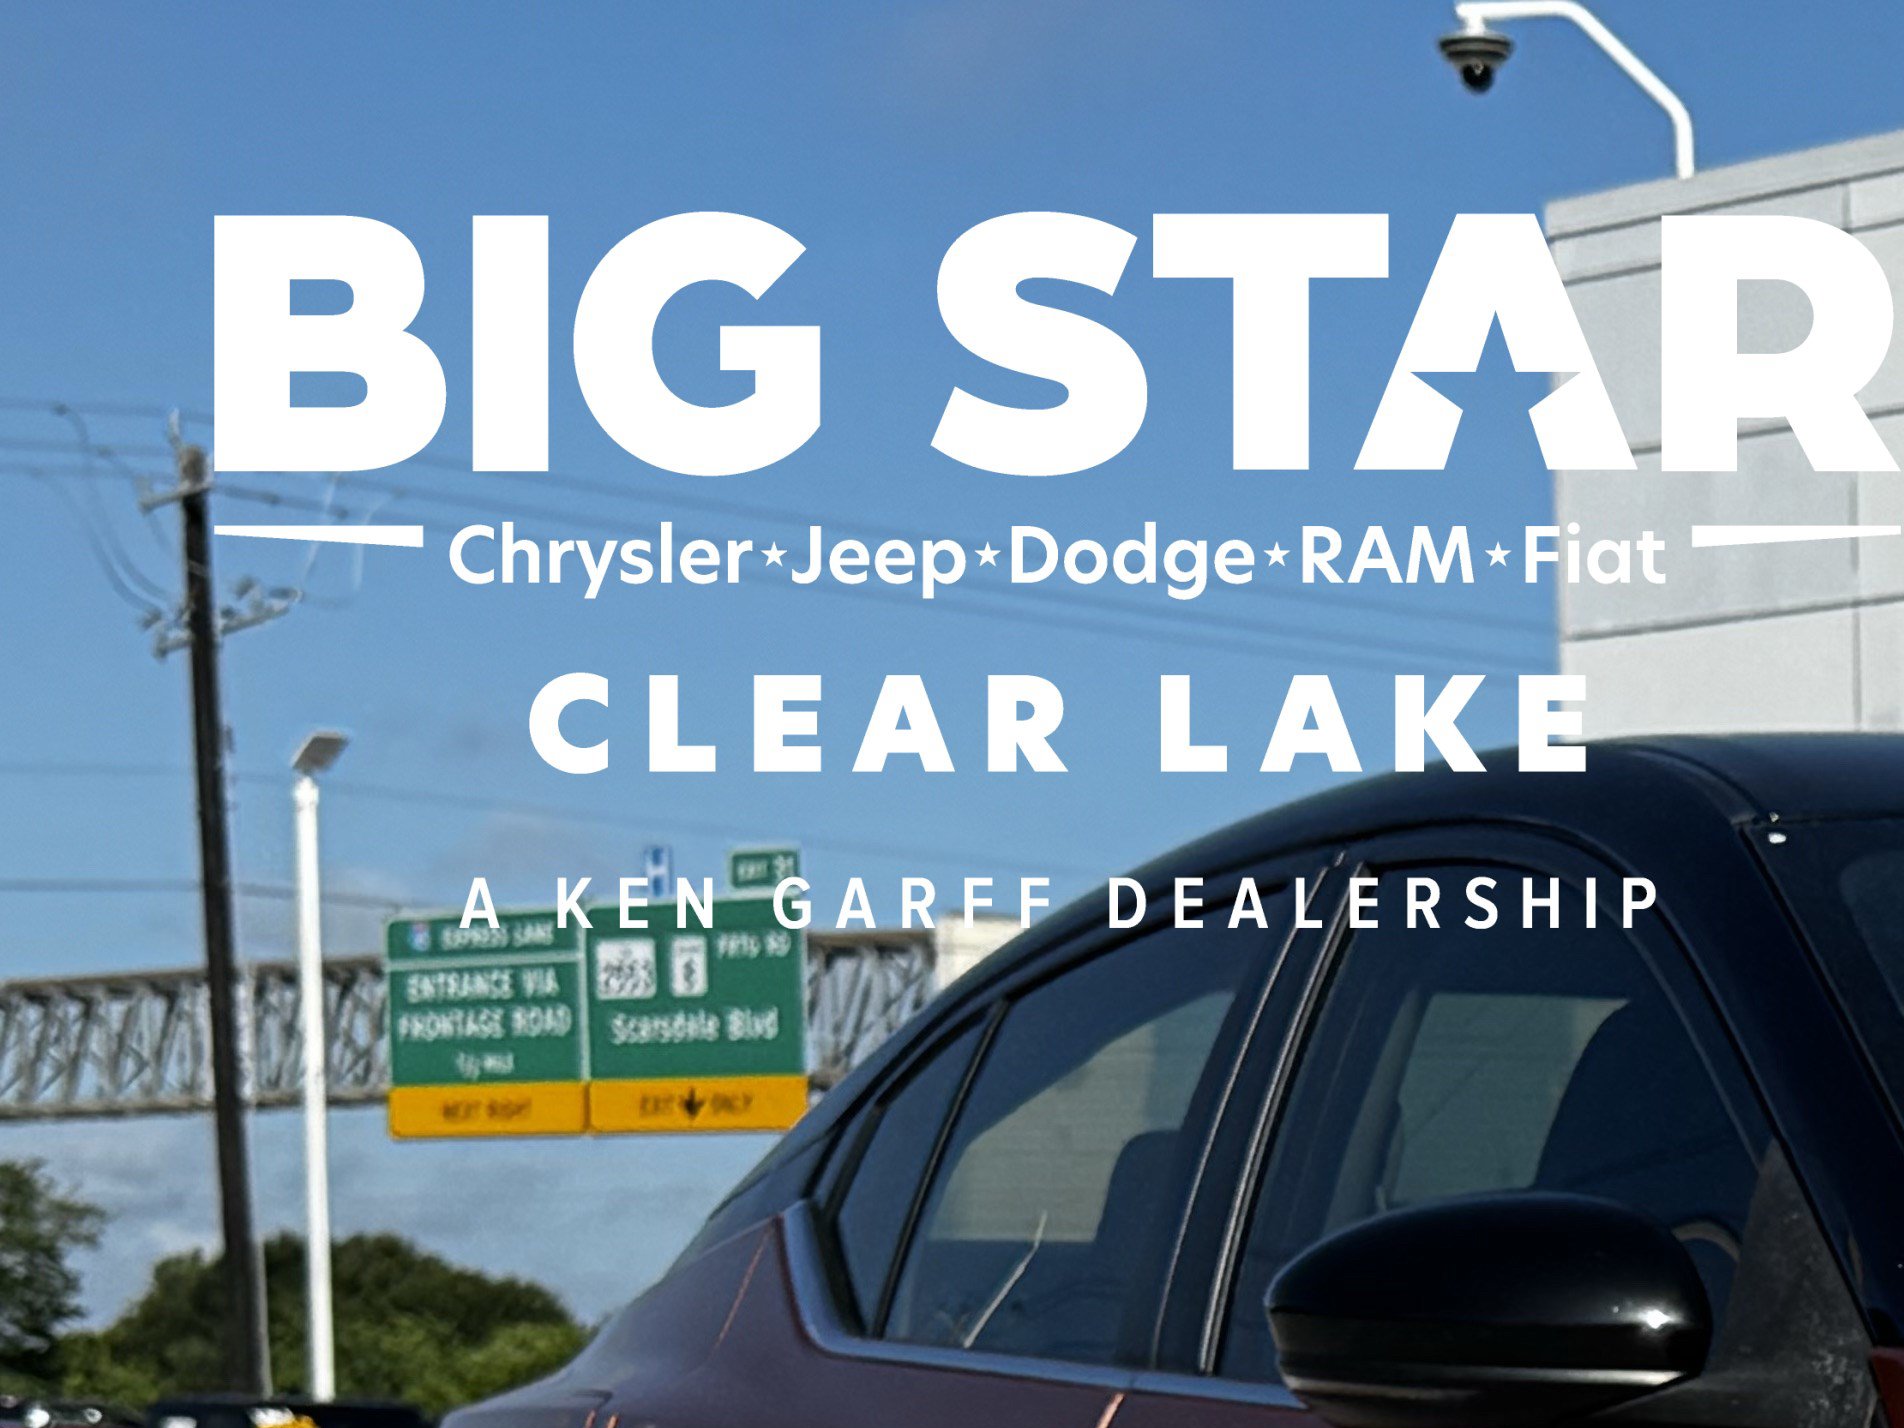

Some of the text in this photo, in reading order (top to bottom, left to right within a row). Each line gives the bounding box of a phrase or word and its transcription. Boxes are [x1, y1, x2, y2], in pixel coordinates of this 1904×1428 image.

[406, 966, 560, 1003] ENTRANCE VIA
[399, 1003, 572, 1041] FRONTAGE ROAD
[611, 1005, 779, 1044] Scarsdale Blvd
